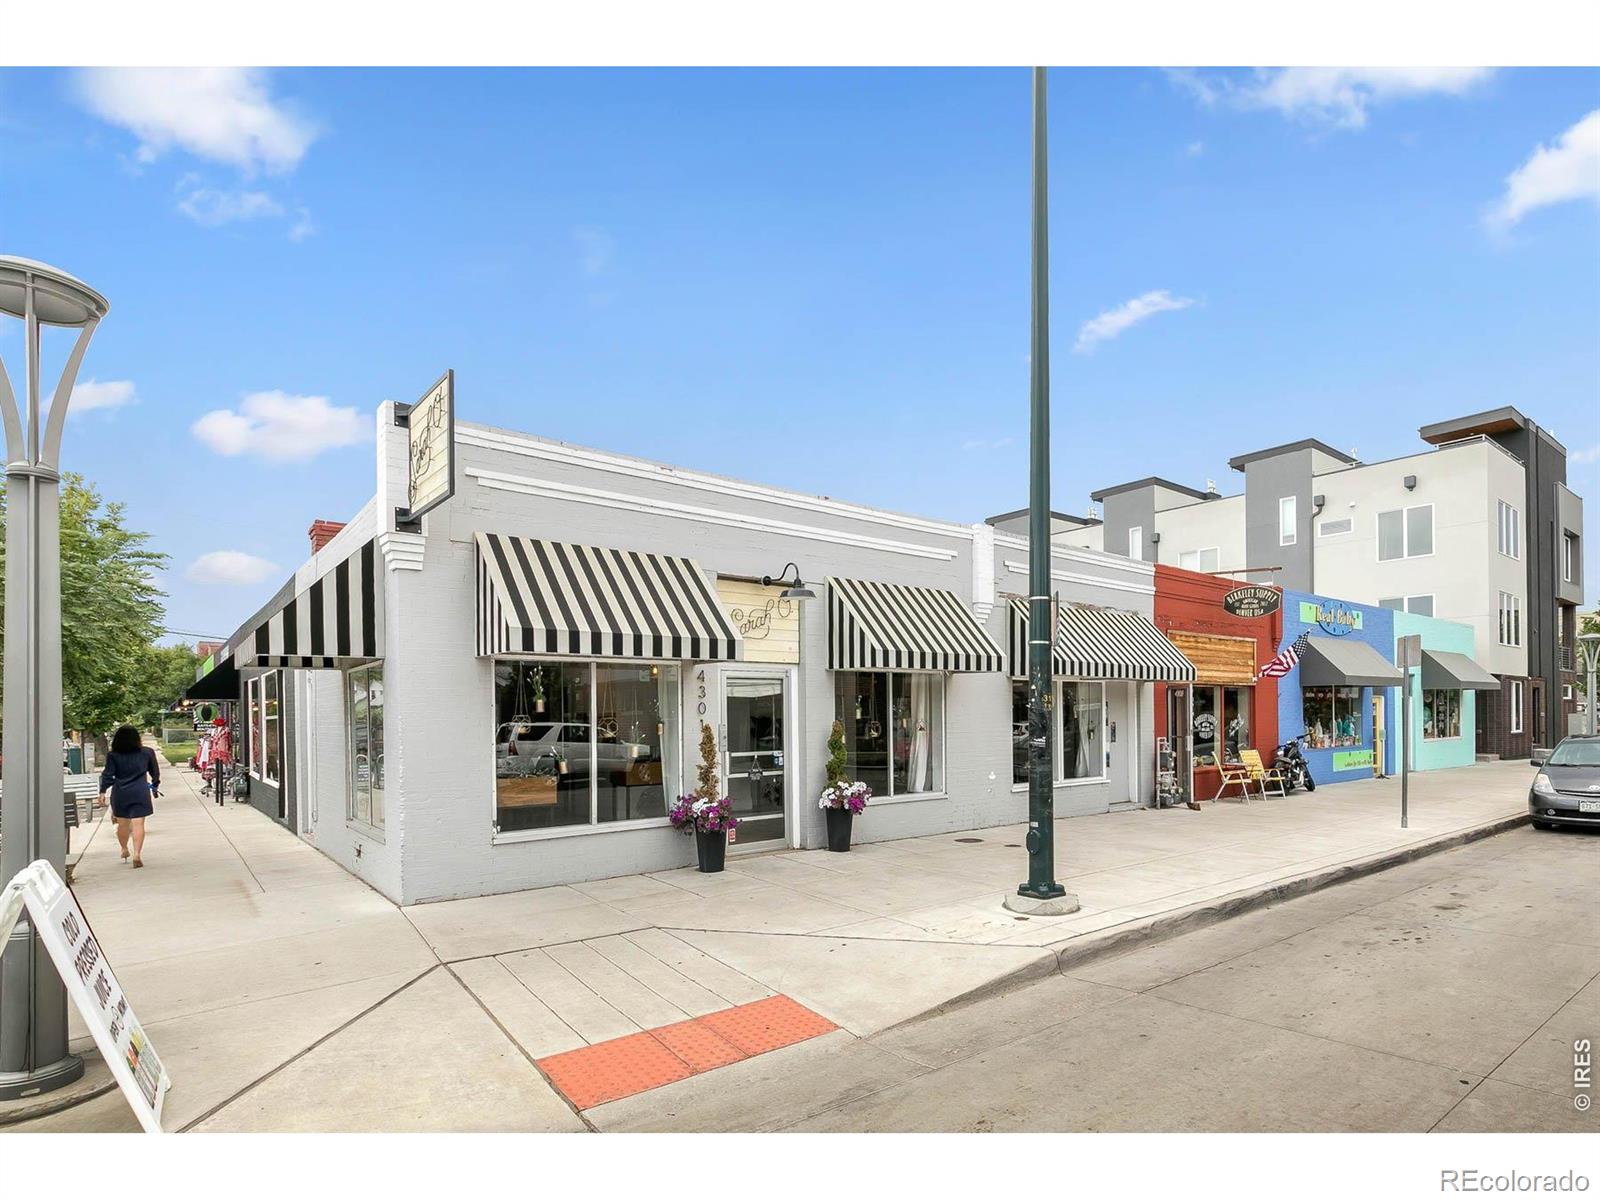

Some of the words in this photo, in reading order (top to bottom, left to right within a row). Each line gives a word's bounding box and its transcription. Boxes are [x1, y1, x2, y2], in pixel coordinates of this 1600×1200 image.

[1226, 588, 1255, 604] BERKELEY
[1255, 588, 1278, 603] SUPPLY
[1235, 608, 1253, 617] DENVER
[1254, 608, 1264, 617] USA
[61, 911, 80, 947] COLD
[74, 935, 99, 986] PRESSED
[93, 968, 112, 1010] JUICE
